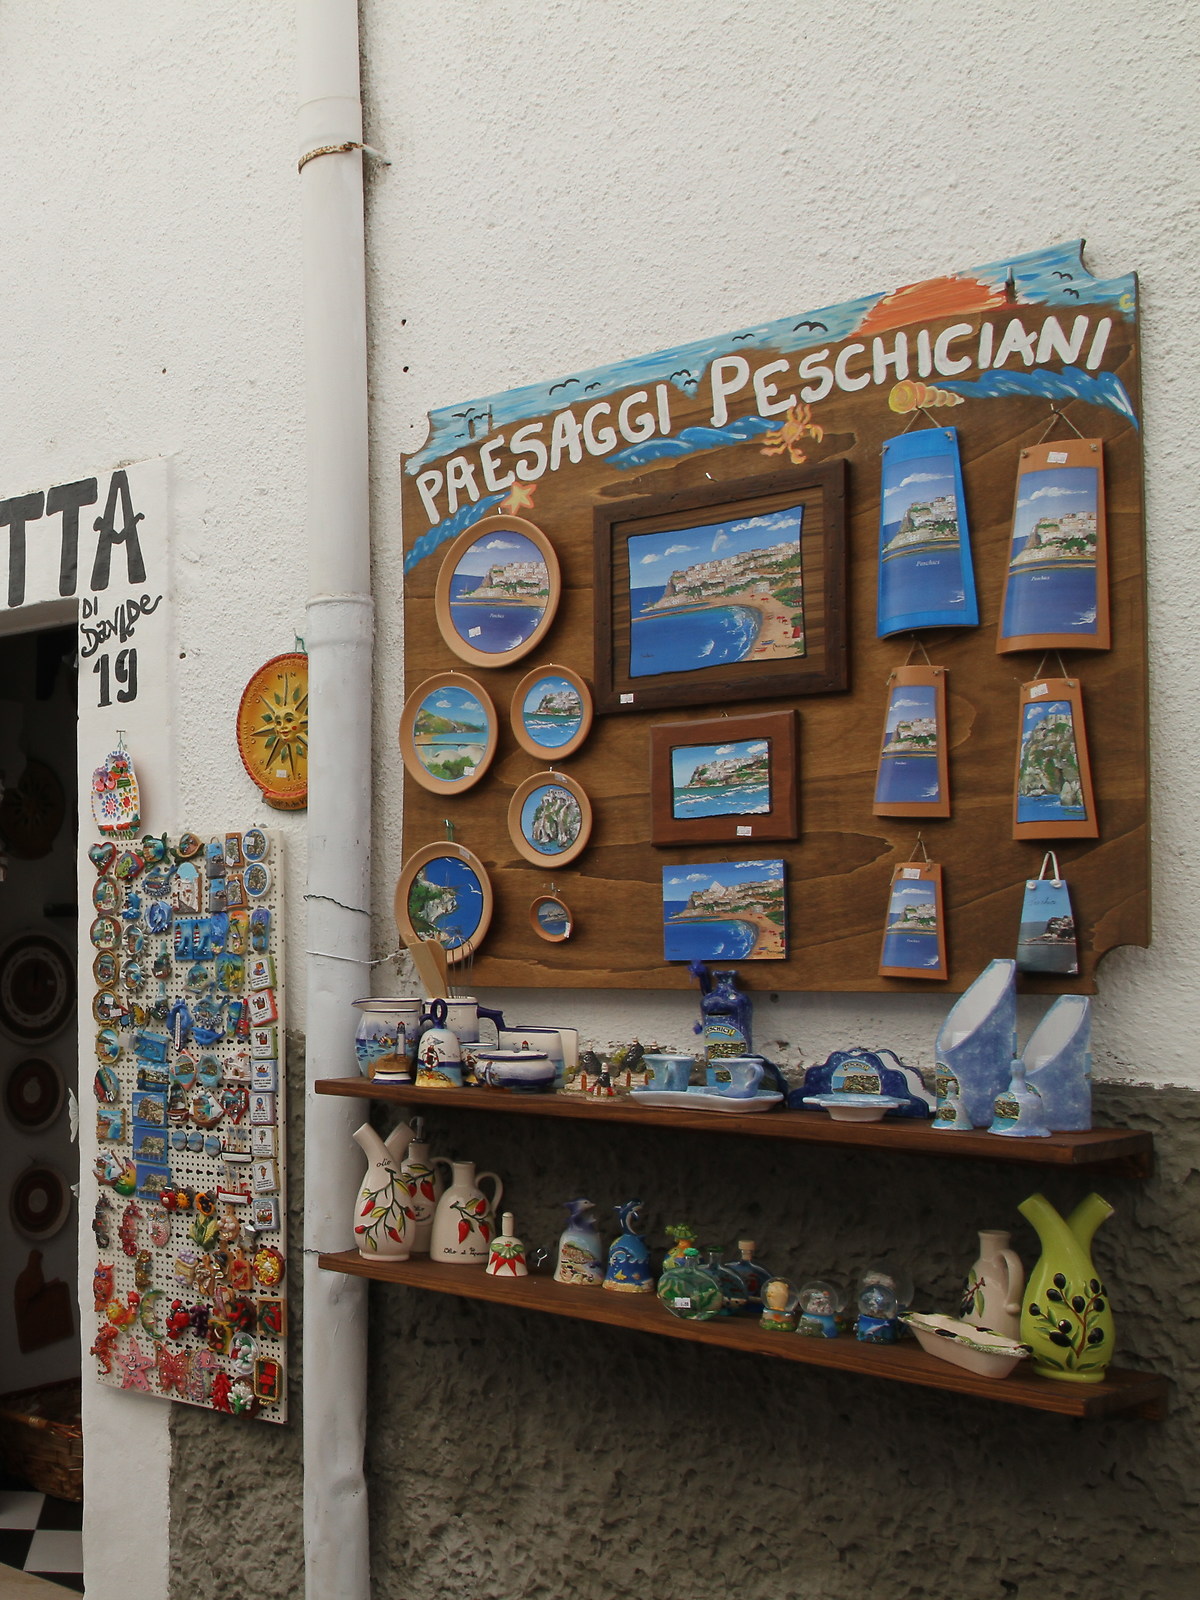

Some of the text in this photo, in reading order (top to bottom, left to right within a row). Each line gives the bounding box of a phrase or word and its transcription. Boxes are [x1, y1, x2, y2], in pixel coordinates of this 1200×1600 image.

[416, 315, 1112, 525] PAESAGGI PESCHICIANI
[83, 596, 98, 619] DI
[93, 648, 138, 707] 19
[376, 1158, 392, 1168] olio
